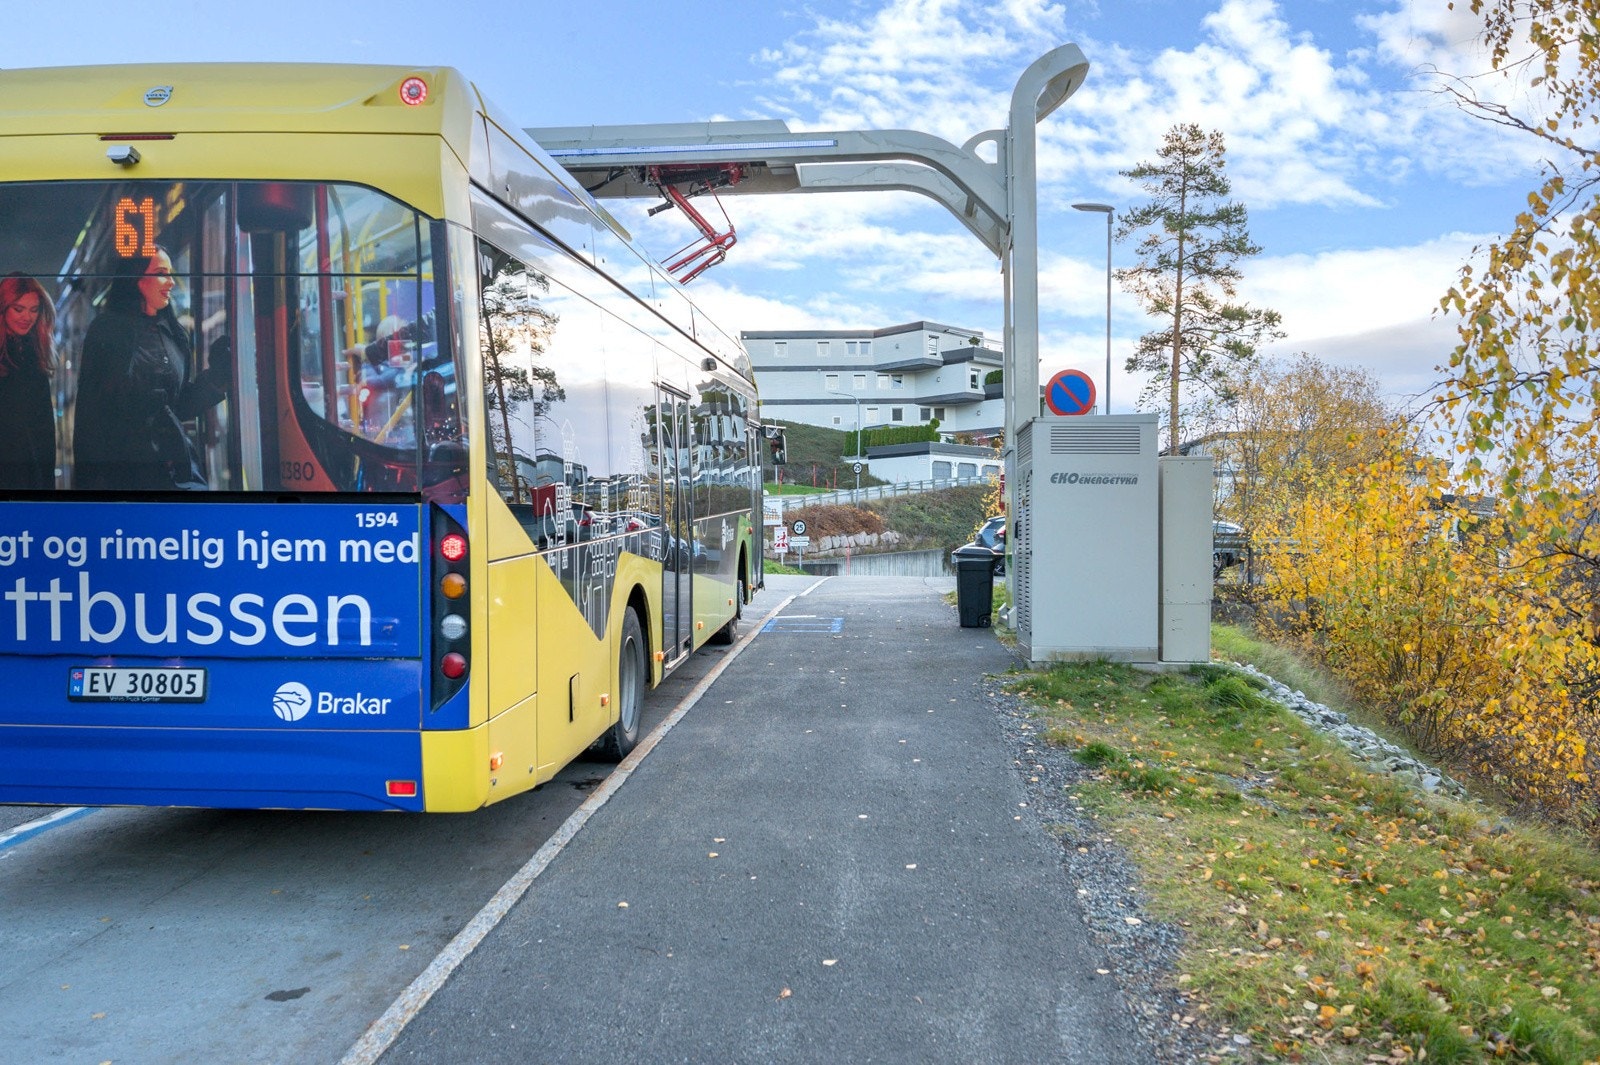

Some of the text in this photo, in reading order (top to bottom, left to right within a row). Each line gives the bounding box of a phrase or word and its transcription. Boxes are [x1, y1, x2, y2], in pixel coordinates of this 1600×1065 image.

[116, 197, 156, 257] 61
[355, 512, 399, 528] 1594
[43, 536, 87, 567] og
[100, 529, 224, 569] rimelig
[237, 530, 326, 569] hjem
[339, 532, 418, 563] med
[4, 571, 371, 647] ttbussen
[89, 672, 197, 695] EV 30805
[317, 692, 392, 714] Brakar
